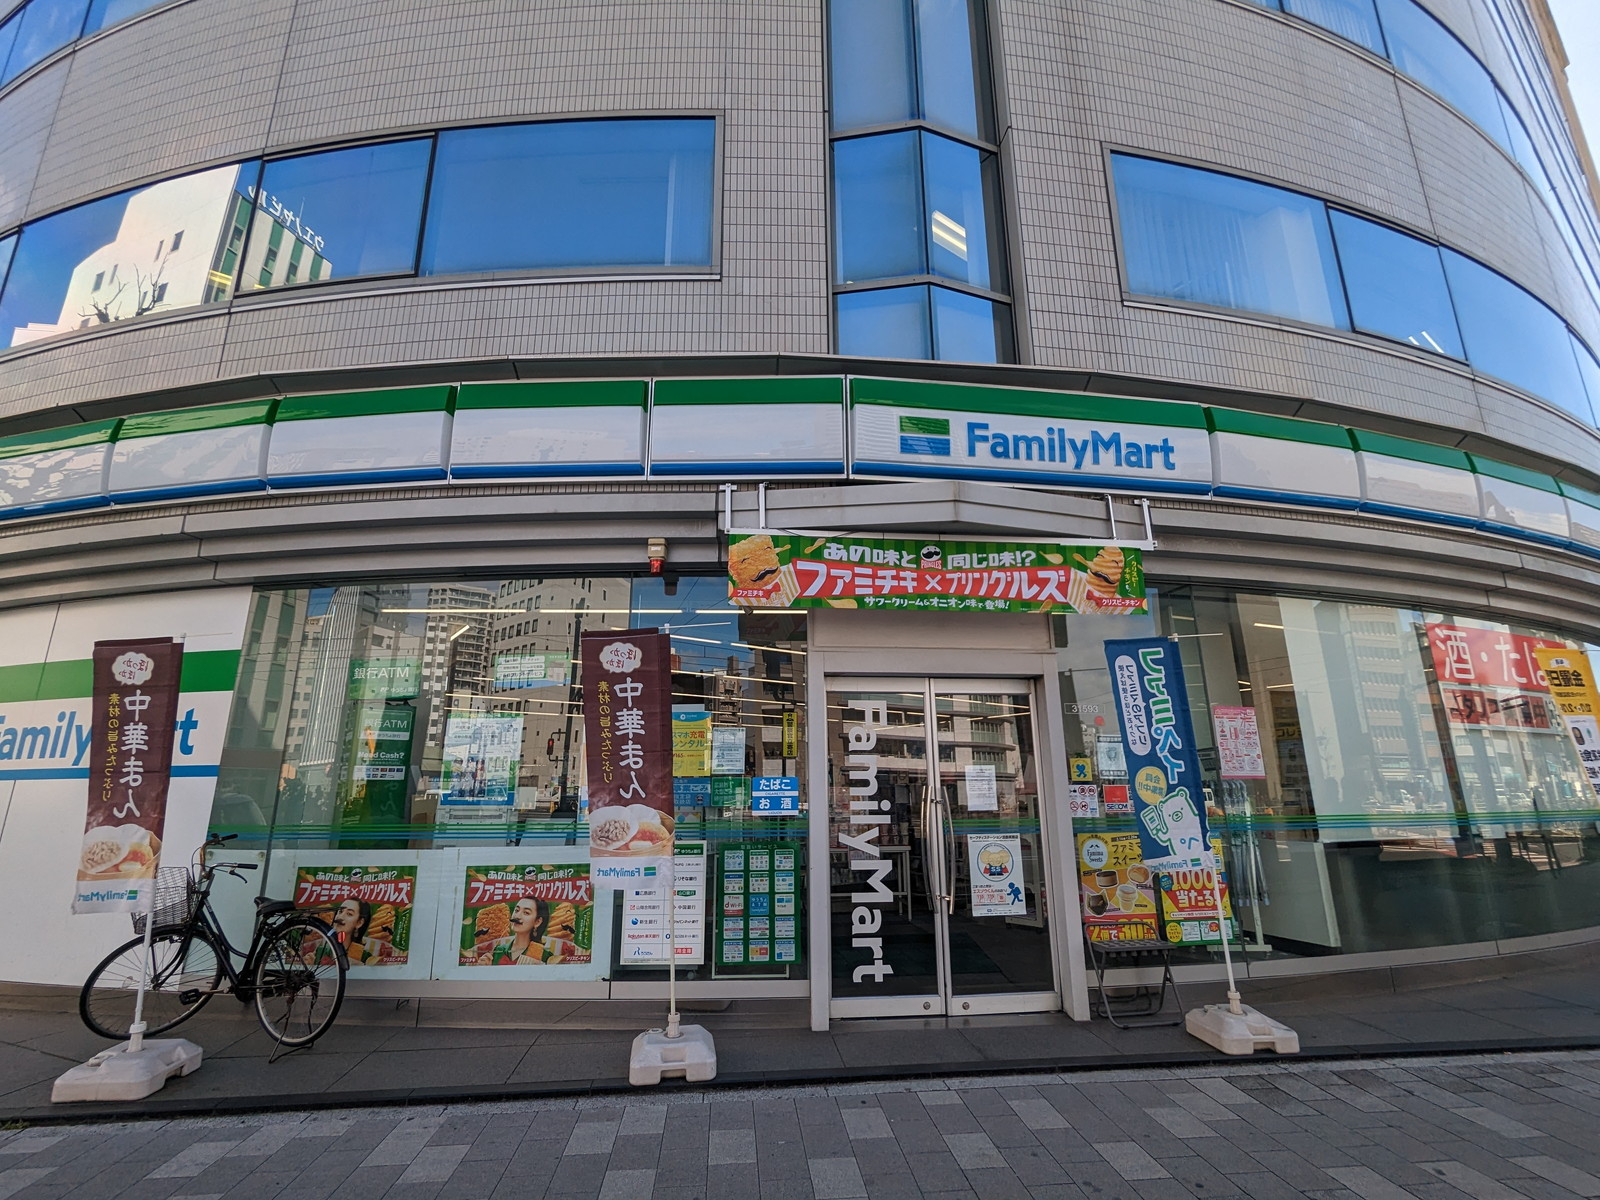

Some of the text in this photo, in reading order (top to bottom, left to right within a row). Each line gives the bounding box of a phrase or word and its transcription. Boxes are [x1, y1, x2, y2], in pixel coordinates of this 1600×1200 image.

[966, 421, 1176, 471] FamilyMart
[823, 542, 917, 569] あの味と
[947, 550, 1037, 570] 同じ味!?
[736, 589, 764, 597] ファミチキ
[864, 596, 1010, 611] サワークリーム&オニオン味で登場!
[1102, 598, 1140, 606] クリスピーチキン
[353, 667, 409, 679] 銀行ATM
[1071, 704, 1099, 713] 31593
[760, 779, 791, 790] たばこ
[838, 700, 894, 983] FamilyMart
[316, 871, 350, 882] あの味と
[487, 870, 523, 882] あの味と
